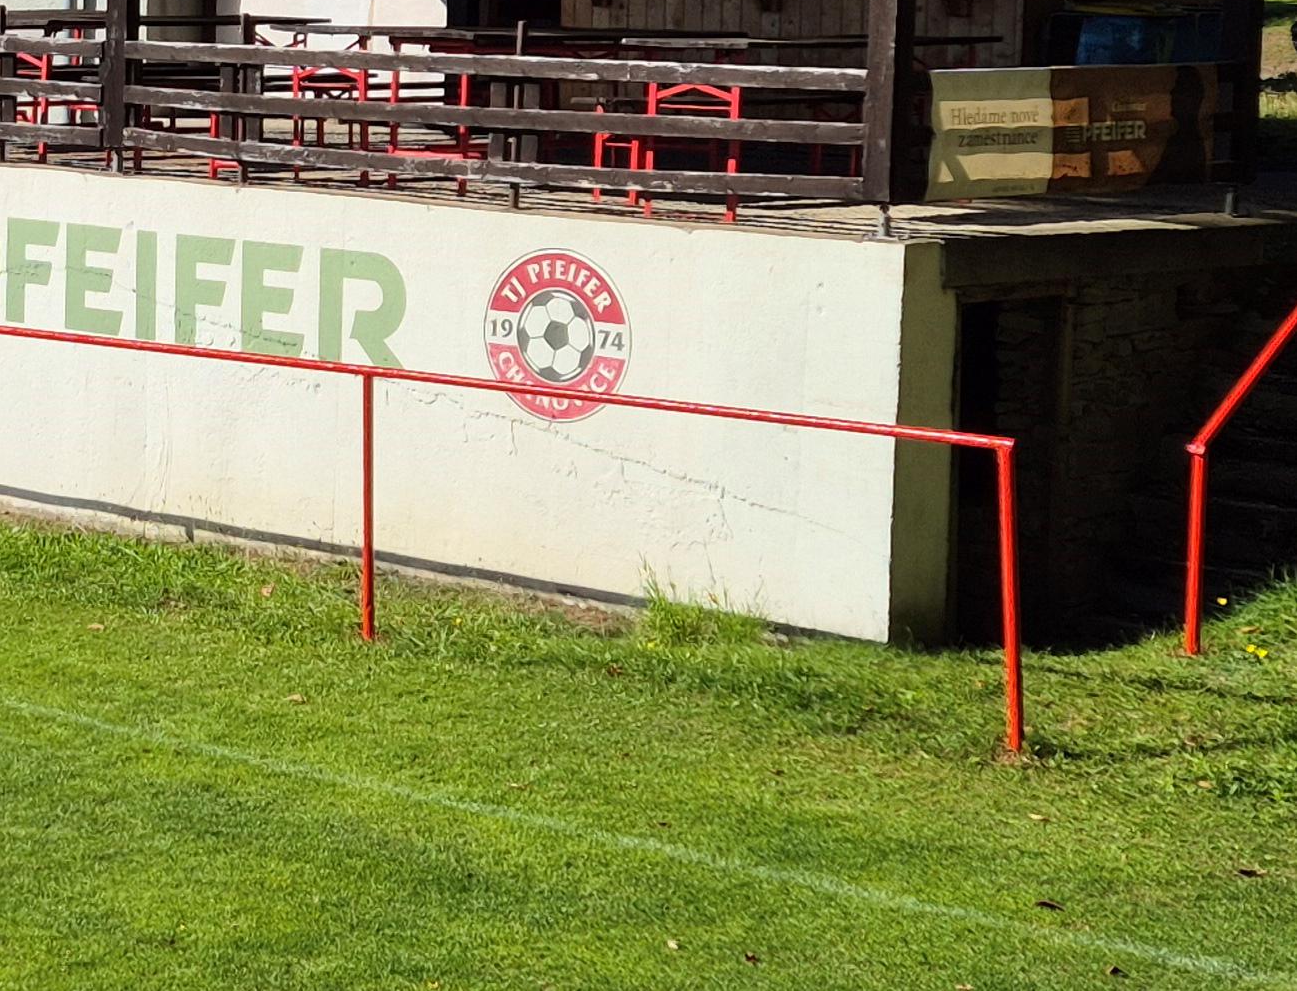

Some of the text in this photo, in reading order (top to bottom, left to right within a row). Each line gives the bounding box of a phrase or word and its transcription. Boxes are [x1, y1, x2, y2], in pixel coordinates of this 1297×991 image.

[1082, 120, 1147, 142] PFEIFER
[501, 259, 612, 314] TJ PFEIFER
[490, 318, 626, 351] 19 74
